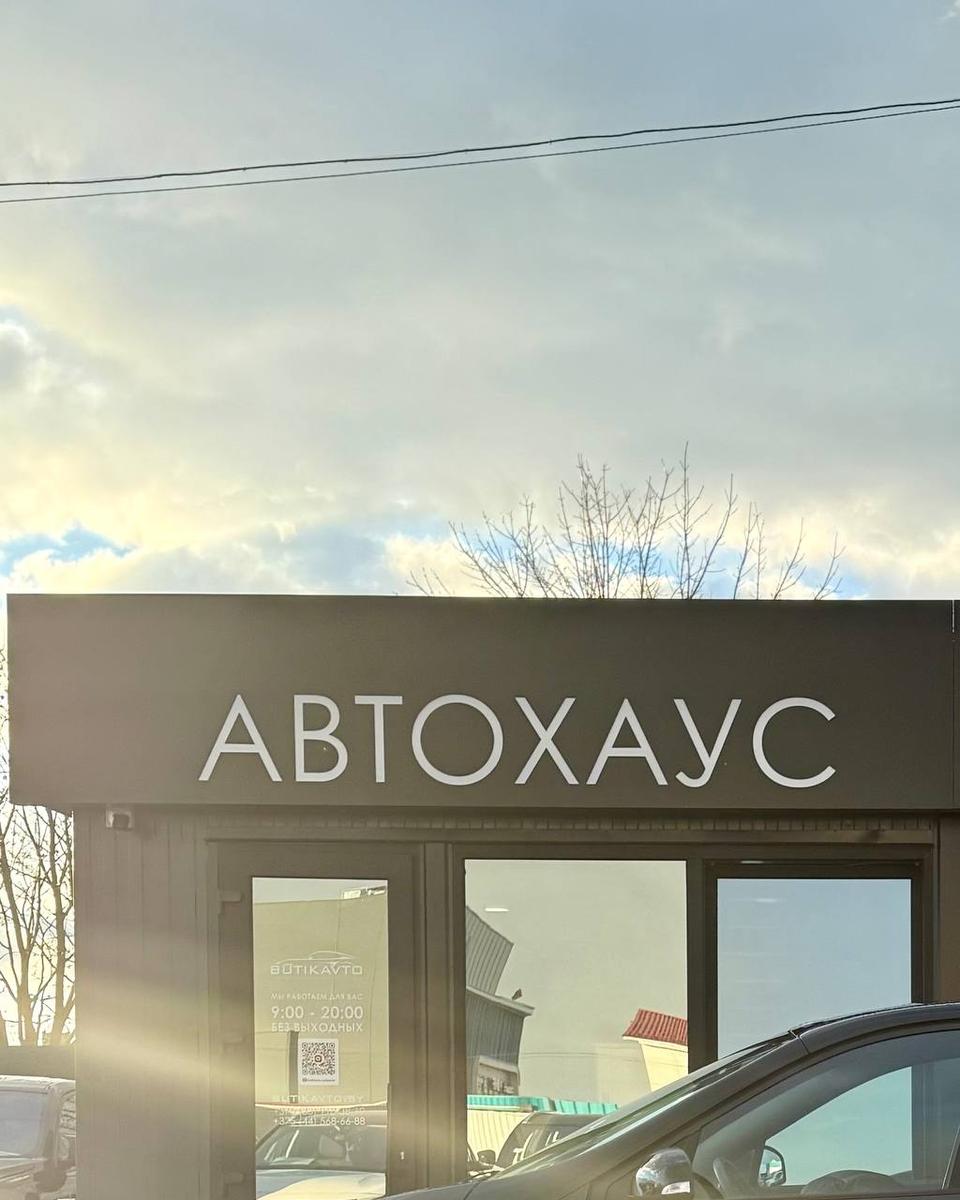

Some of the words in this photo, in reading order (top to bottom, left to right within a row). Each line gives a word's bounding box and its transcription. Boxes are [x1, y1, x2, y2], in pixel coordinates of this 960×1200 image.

[198, 694, 836, 788] АВТОХАУС
[270, 964, 363, 975] BUTIKAVTO
[271, 1006, 304, 1019] 9:00
[320, 1006, 364, 1019] 20:00
[271, 1022, 290, 1032] БЕЗ
[294, 1022, 363, 1032] ВЫХОДНЫХ
